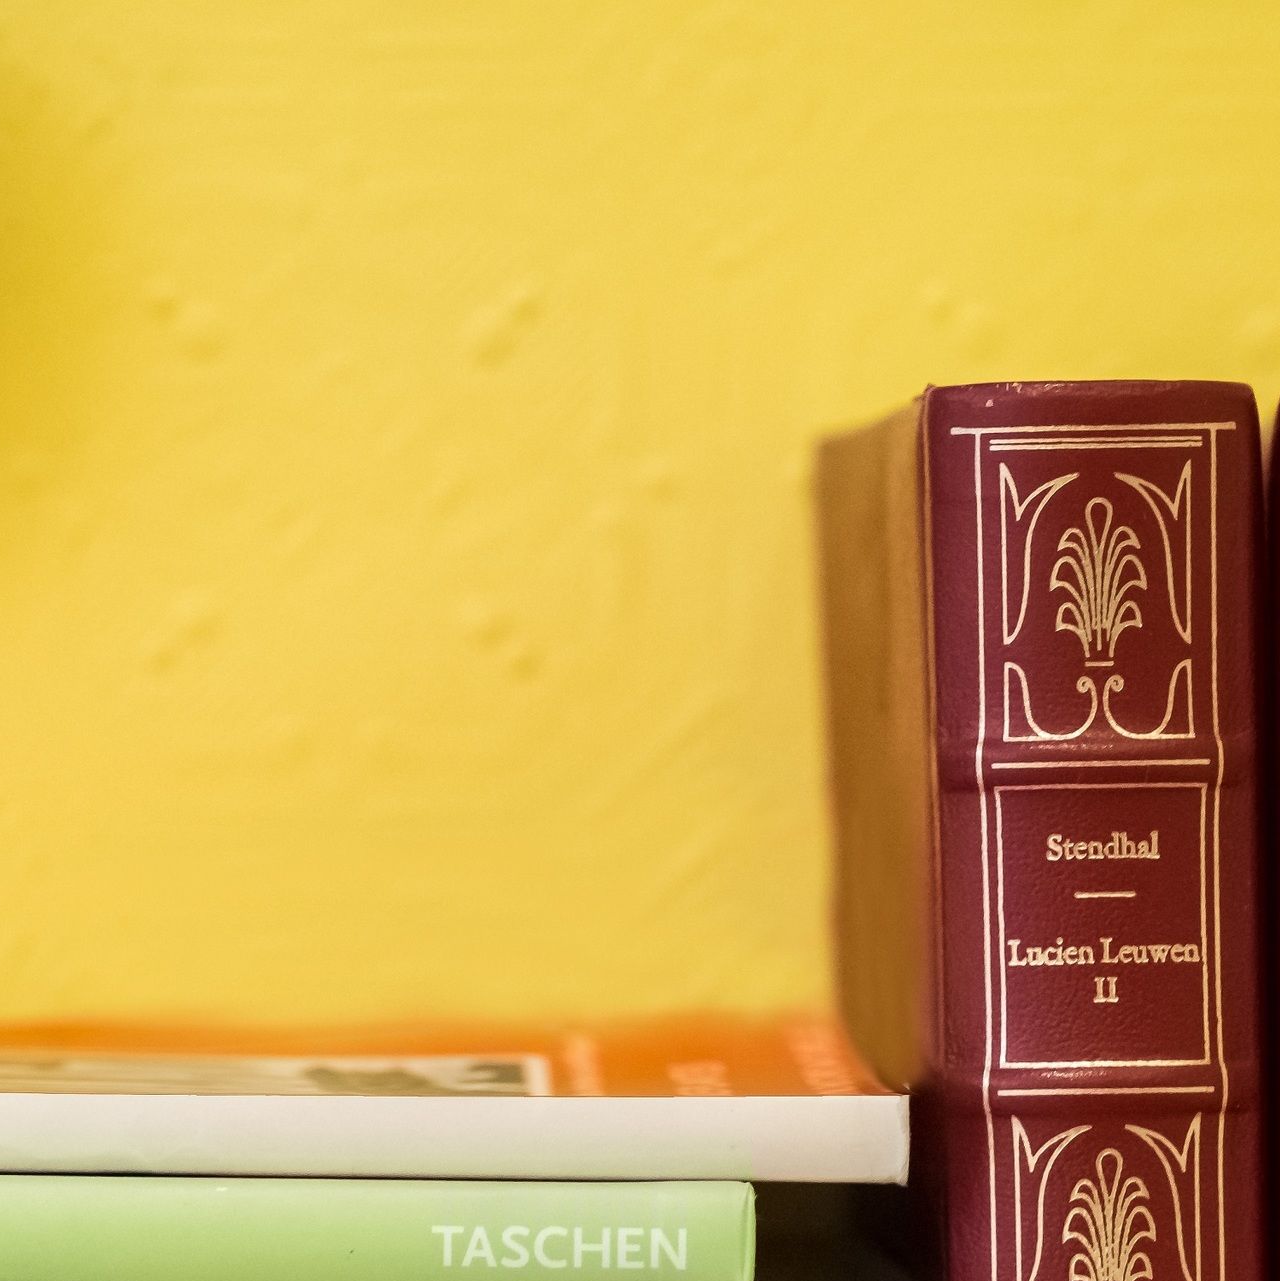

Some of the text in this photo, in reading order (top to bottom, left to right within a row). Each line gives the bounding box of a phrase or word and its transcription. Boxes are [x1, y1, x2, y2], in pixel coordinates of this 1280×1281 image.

[1047, 831, 1160, 861] Stendhal
[1008, 938, 1200, 966] Lucien Leuwen
[1094, 977, 1118, 1003] II
[432, 1225, 688, 1271] TASCHEN
